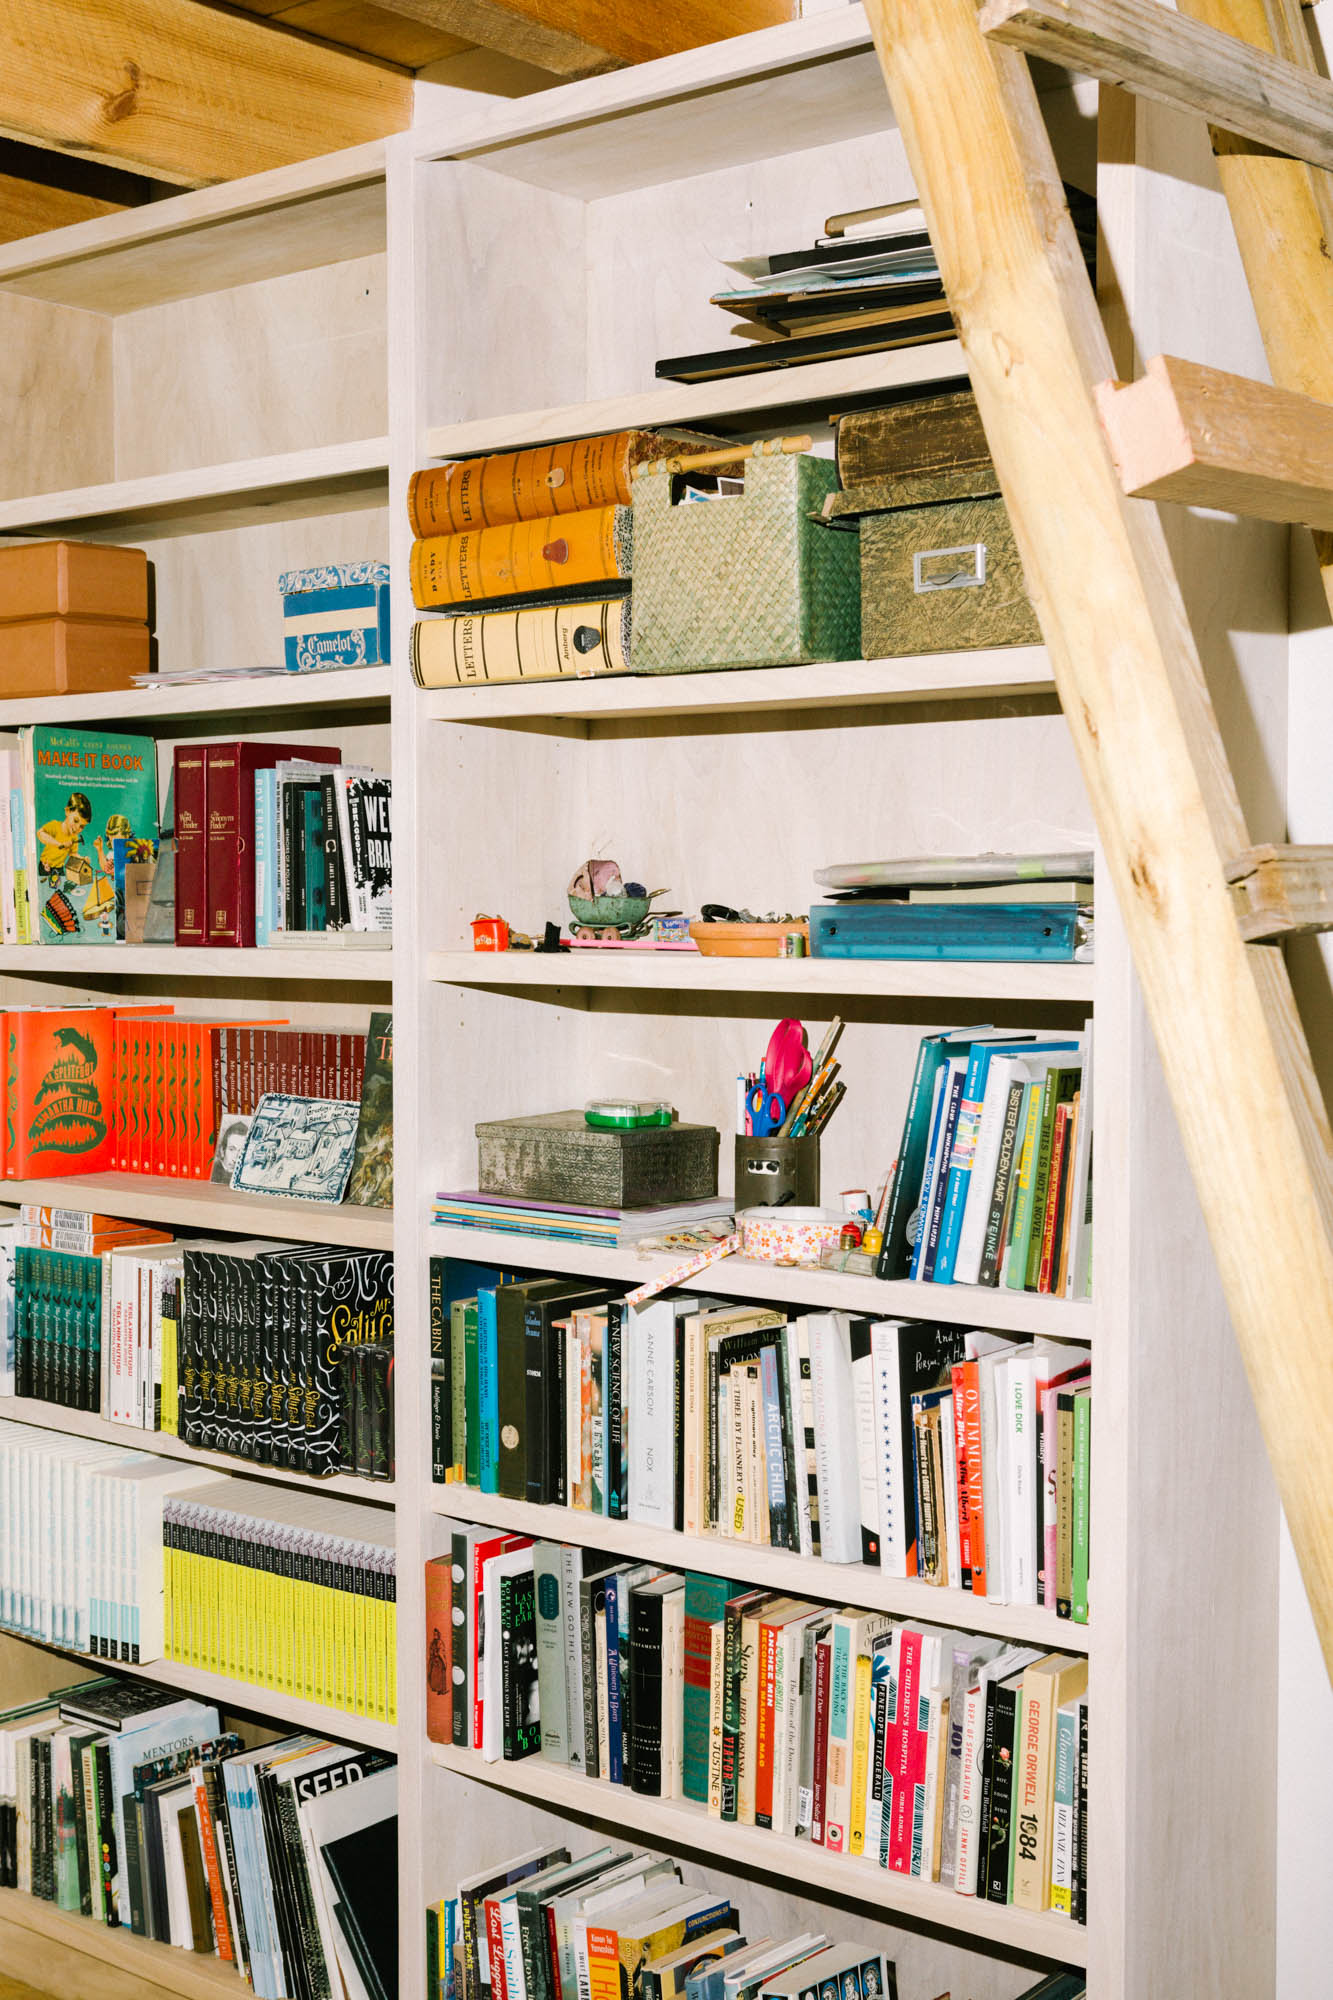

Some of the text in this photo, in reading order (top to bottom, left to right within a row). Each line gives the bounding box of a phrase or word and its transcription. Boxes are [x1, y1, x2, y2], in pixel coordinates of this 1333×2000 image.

[460, 470, 472, 522] LETTERS
[429, 551, 438, 592] DANDY
[459, 536, 472, 599] LETTERS
[307, 634, 352, 655] Camelot
[463, 618, 477, 678] LETTERS
[561, 627, 570, 660] Amberg
[37, 749, 144, 771] MAKE-IT BOOK
[76, 1098, 98, 1114] HUNT
[1007, 1088, 1021, 1126] SISTER
[942, 1132, 952, 1174] UNKNOWING
[998, 1128, 1014, 1174] GOLDEN
[995, 1176, 1007, 1202] HAIR
[1032, 1124, 1051, 1240] THIS IS NOT A NOVEL
[929, 1206, 941, 1248] MIMI LIPSON
[432, 1276, 442, 1352] THE CABIN
[612, 1315, 620, 1323] A
[612, 1327, 620, 1355] NEW
[611, 1358, 620, 1406] SCIENCE
[1015, 1388, 1023, 1410] LOVE
[305, 1388, 320, 1429] Splitfoot
[612, 1408, 620, 1424] OF
[955, 1390, 966, 1448] After Birth
[612, 1424, 620, 1444] LIFE
[734, 1390, 743, 1483] THREE BY FLANNERY
[966, 1389, 982, 1514] ON IMMUNITY
[768, 1403, 784, 1508] ARCTIC CHILL
[922, 1476, 930, 1502] LONELY
[734, 1497, 744, 1529] USED
[924, 1503, 932, 1531] HUNTER
[504, 1580, 513, 1629] ROBERTO
[580, 1605, 590, 1640] COMING
[582, 1654, 592, 1684] WRITING
[608, 1658, 618, 1691] Unicorn
[504, 1694, 510, 1704] ON
[585, 1702, 593, 1723] OTHER
[609, 1692, 618, 1700] Is
[610, 1701, 620, 1722] Born
[902, 1668, 912, 1726] CHILDREN'S
[585, 1727, 594, 1756] ESSAYS
[789, 1720, 796, 1729] of
[874, 1685, 886, 1798] PENELOPE FITZGERALD
[950, 1722, 963, 1759] JOY
[986, 1705, 995, 1749] PROXIES
[142, 1735, 194, 1761] MENTORS
[712, 1741, 723, 1792] JUSTINE
[723, 1736, 735, 1780] VIATOR
[900, 1729, 909, 1776] HOSPITAL
[963, 1703, 976, 1800] DEPT. OF SPECULATION
[299, 1763, 364, 1801] SEED
[1019, 1700, 1040, 1861] GEORGE ORWELL 1984
[981, 1797, 990, 1833] Blanchfield
[1056, 1728, 1072, 1883] Gloaming MELANIE FINN
[958, 1827, 970, 1886] JENNY OFFILL
[463, 1908, 474, 1969] PUBLIC SPACE
[489, 1906, 502, 1938] Lost
[521, 1926, 533, 1990] Free Love
